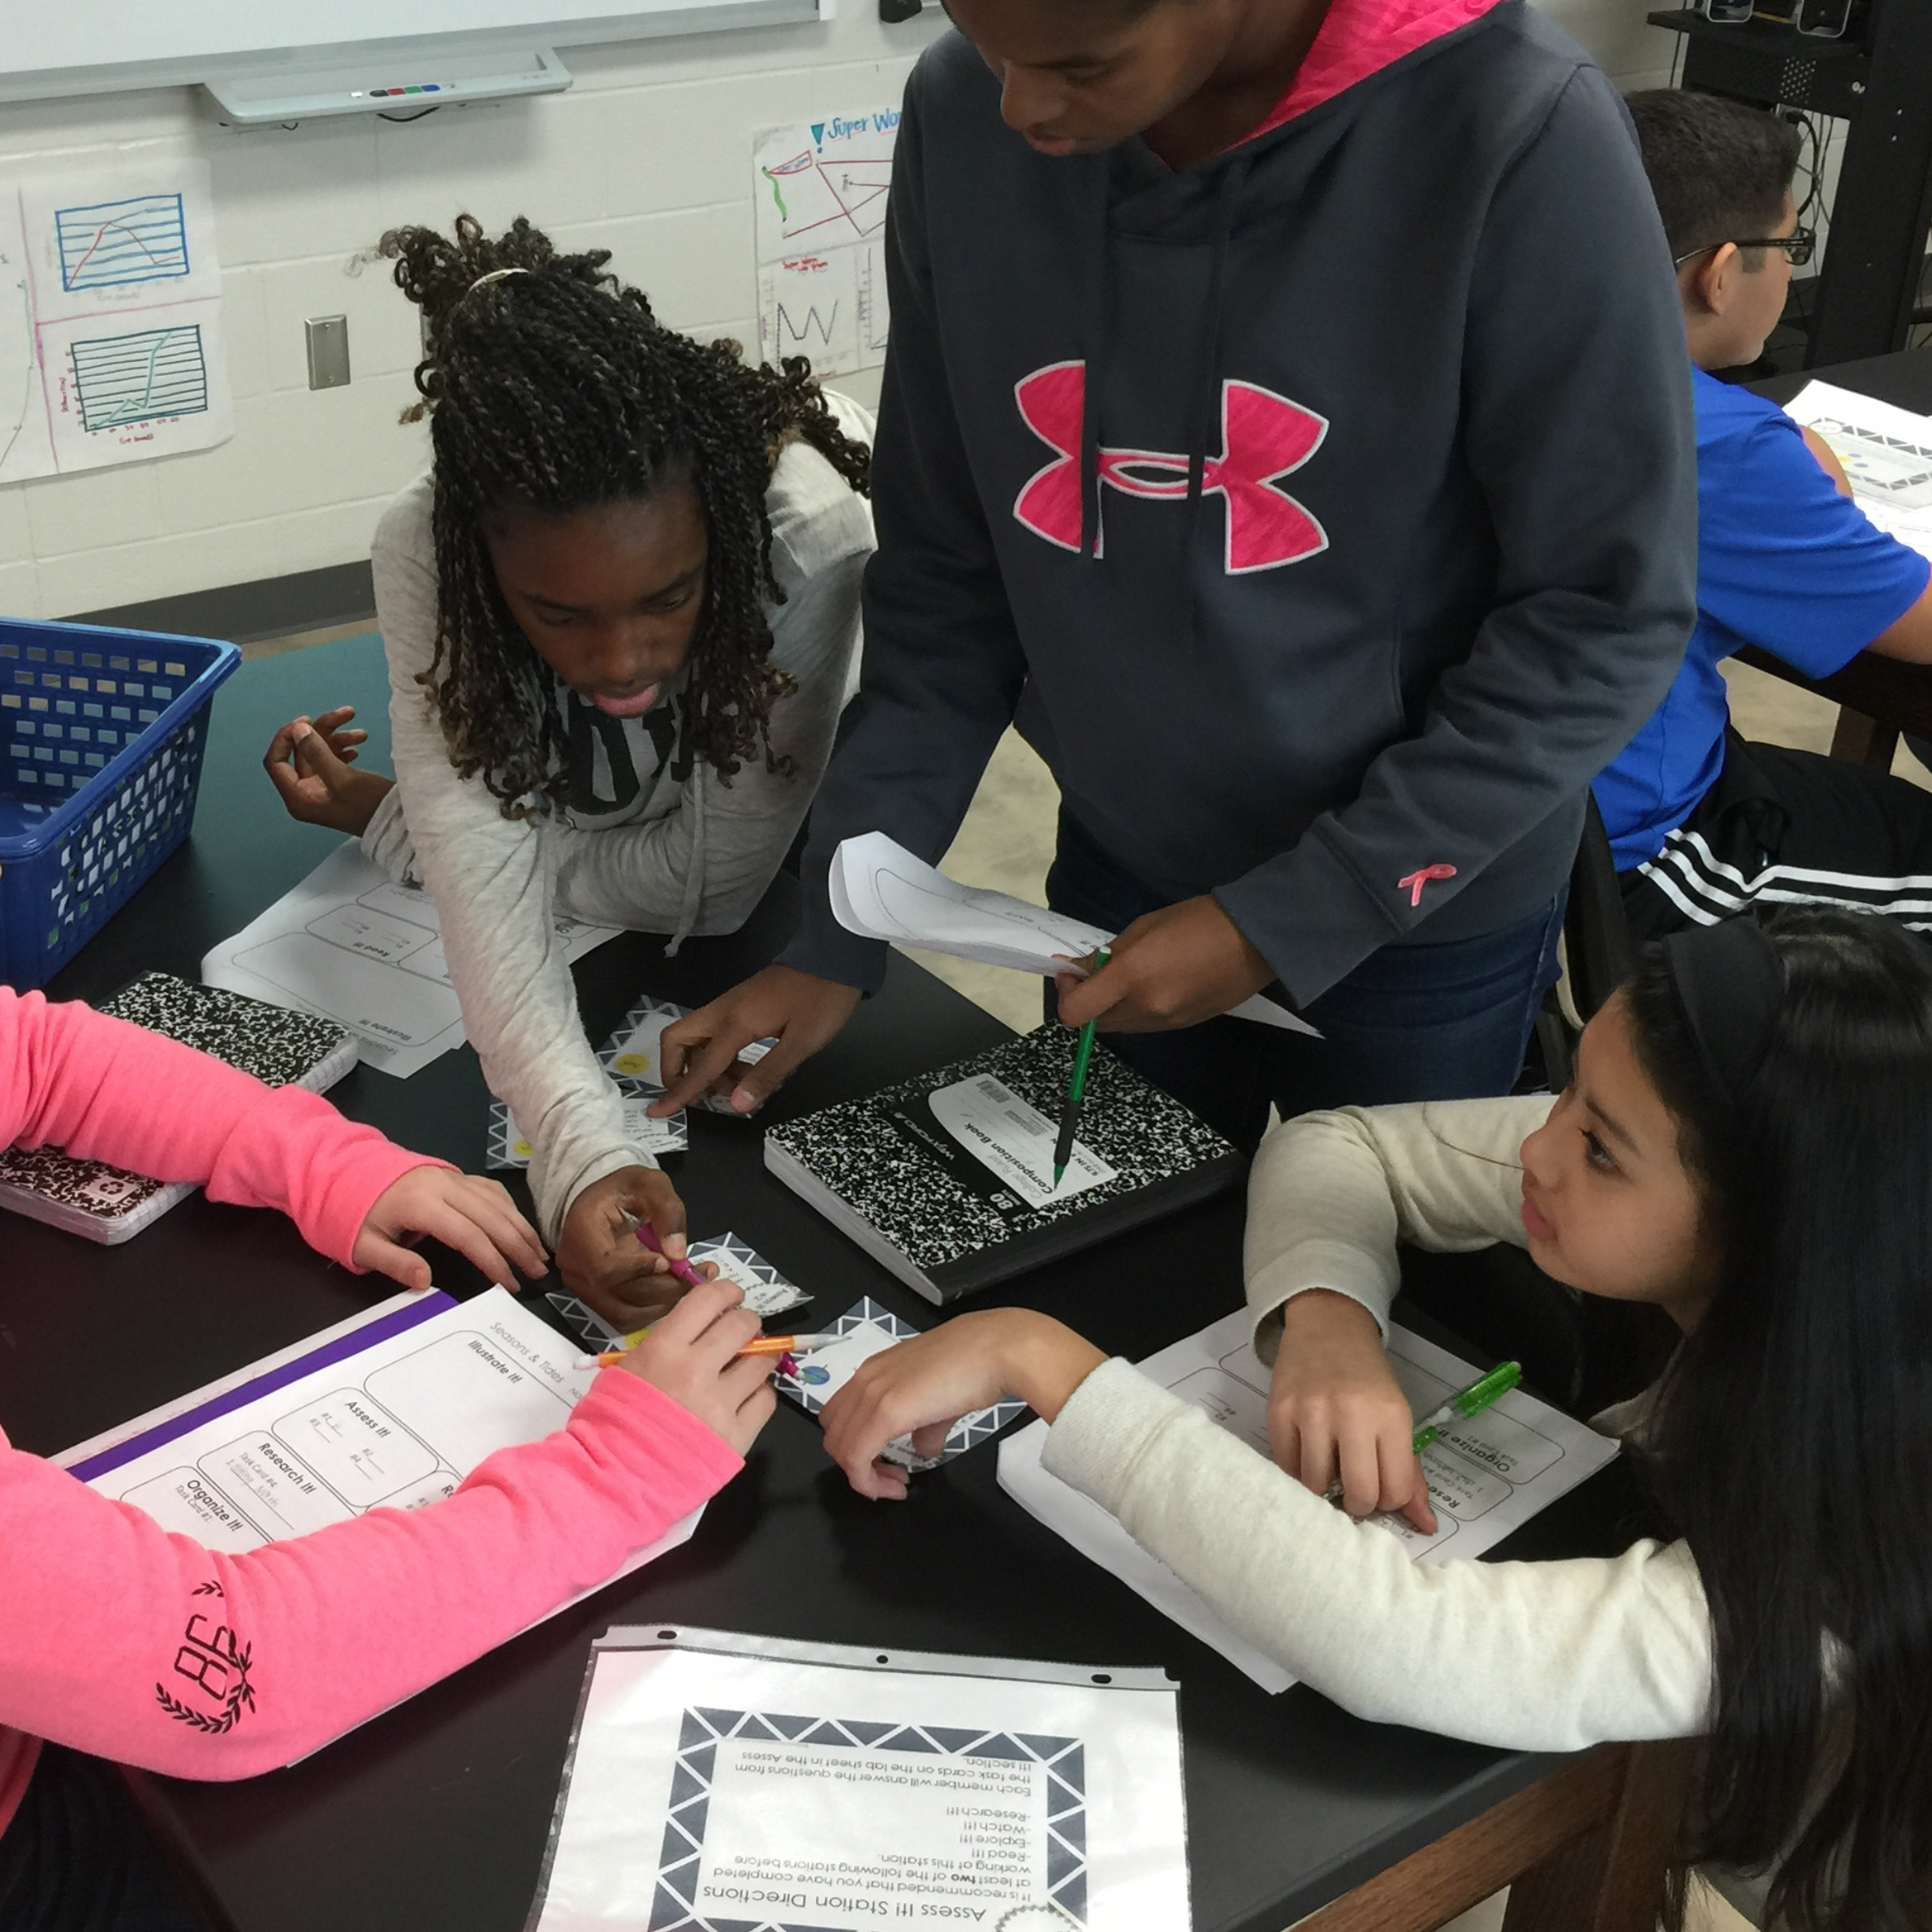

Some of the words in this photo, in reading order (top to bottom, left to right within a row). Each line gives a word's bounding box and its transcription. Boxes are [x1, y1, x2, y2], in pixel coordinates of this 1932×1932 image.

[827, 117, 869, 140] Super
[873, 108, 902, 132] Wo
[964, 1123, 992, 1143] Book
[991, 1143, 1053, 1194] Composition
[990, 1193, 1016, 1209] 80
[489, 1322, 530, 1355] Seasons
[528, 1354, 540, 1363] &
[539, 1361, 565, 1383] Tides
[468, 1340, 509, 1374] Illustrate
[507, 1373, 523, 1383] It!
[345, 1402, 378, 1429] Assess
[376, 1427, 390, 1438] It!
[1452, 1437, 1510, 1472] Organize
[240, 1452, 254, 1466] Task
[252, 1464, 270, 1479] Card
[258, 1443, 304, 1485] Research
[300, 1482, 317, 1494] It!
[1434, 1473, 1455, 1486] Card
[175, 1485, 189, 1499] Task
[188, 1498, 205, 1514] Card
[187, 1480, 230, 1521] Organize
[226, 1520, 244, 1532] It!
[742, 1753, 782, 1762] Assess
[786, 1756, 807, 1765] the
[811, 1757, 823, 1766] in
[962, 1757, 1017, 1769] section.
[826, 1759, 862, 1769] sheet
[865, 1762, 887, 1771] lab
[891, 1764, 912, 1774] the
[1017, 1760, 1033, 1771] It!
[735, 1765, 765, 1775] from
[768, 1766, 830, 1778] questions
[938, 1767, 975, 1777] cards
[834, 1772, 856, 1782] the
[860, 1774, 908, 1784] answer
[910, 1778, 932, 1787] will
[979, 1772, 1005, 1782] task
[1008, 1774, 1030, 1783] the
[934, 1780, 993, 1791] member
[996, 1785, 1031, 1796] Each
[947, 1807, 959, 1816] It!
[961, 1807, 1030, 1822] -Research
[964, 1821, 972, 1830] It!
[973, 1822, 1029, 1834] -Watch
[960, 1835, 972, 1844] It!
[976, 1835, 1030, 1848] -Explore
[972, 1848, 985, 1858] It!
[988, 1850, 1025, 1861] -Read
[735, 1856, 780, 1869] before
[783, 1860, 836, 1873] stations
[879, 1855, 928, 1867] station.
[931, 1858, 954, 1869] this
[958, 1861, 972, 1869] at
[839, 1862, 901, 1878] following
[976, 1860, 1030, 1874] working
[714, 1868, 793, 1881] completed
[906, 1869, 929, 1881] the
[932, 1873, 947, 1882] of
[951, 1874, 976, 1884] two
[797, 1874, 833, 1887] have
[836, 1878, 862, 1887] you
[866, 1881, 894, 1891] that
[978, 1876, 1012, 1887] least
[1016, 1879, 1030, 1887] at
[897, 1882, 1006, 1898] recommended
[1009, 1891, 1019, 1900] is
[704, 1886, 806, 1908] Directions
[1022, 1894, 1030, 1902] It
[816, 1896, 888, 1915] Station
[896, 1903, 913, 1917] It!
[921, 1904, 986, 1921] Assess
